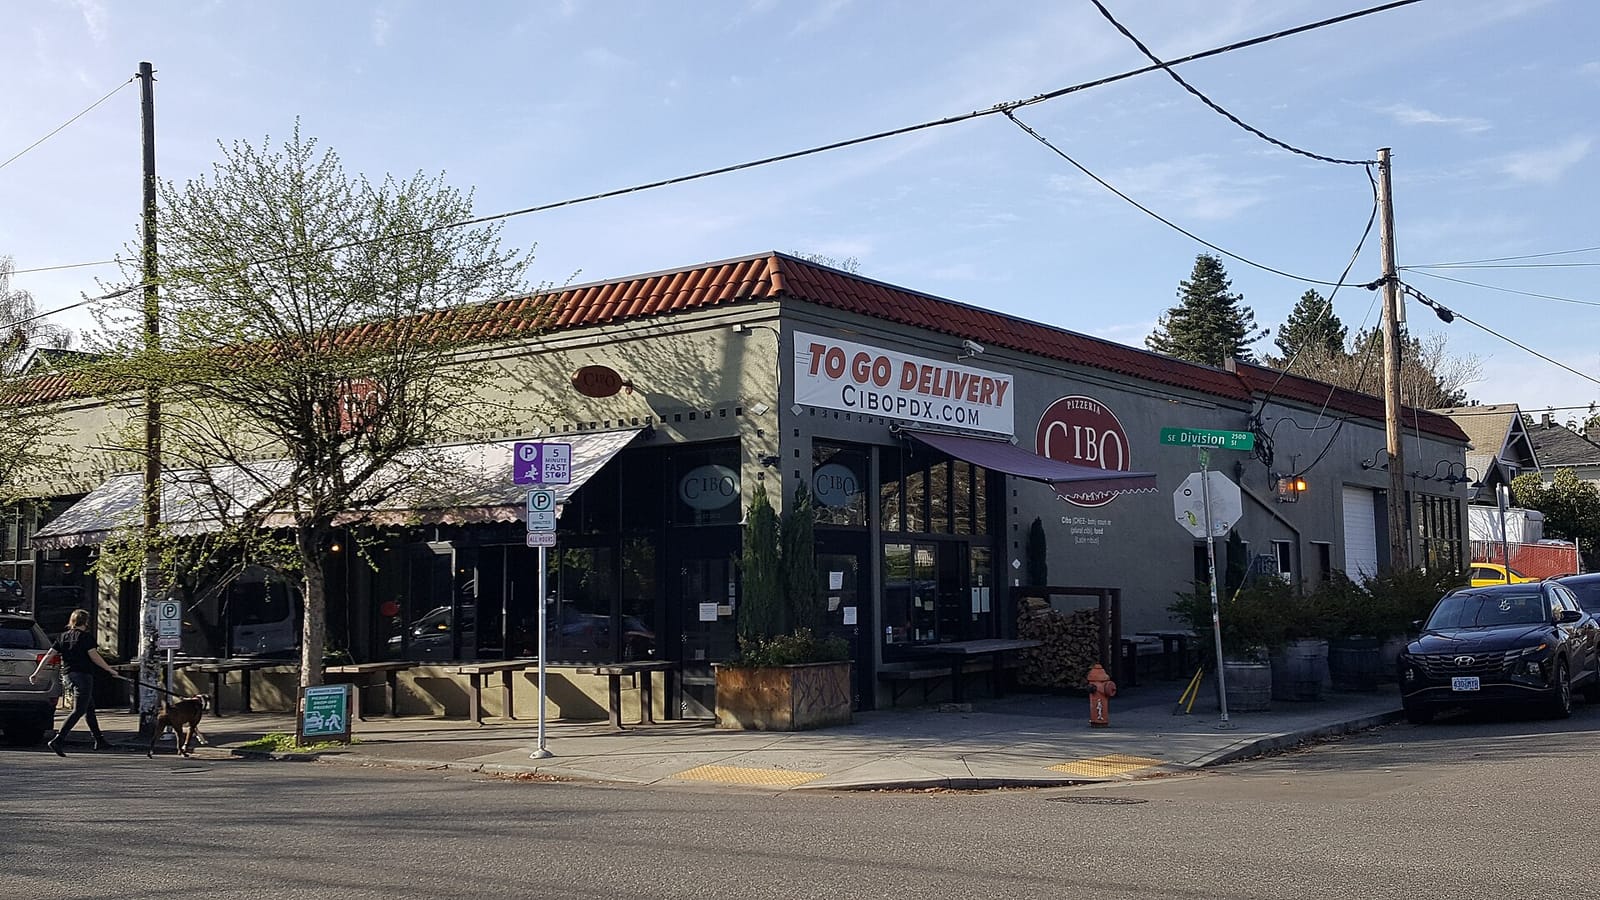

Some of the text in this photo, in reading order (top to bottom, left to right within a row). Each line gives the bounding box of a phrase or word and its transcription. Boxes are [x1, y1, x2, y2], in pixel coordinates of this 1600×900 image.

[809, 342, 1010, 407] TO GO DELIVERY
[841, 384, 980, 426] CIBOPDX.COM
[1066, 400, 1101, 415] PIZZERIA
[1167, 432, 1225, 445] SE Division
[1044, 420, 1123, 472] CIBO
[524, 447, 533, 459] P
[553, 449, 559, 457] 5
[545, 463, 567, 471] FAST
[545, 471, 567, 479] STOP
[684, 475, 735, 500] CIBO
[816, 474, 856, 497] CIBO
[537, 495, 547, 507] P
[166, 606, 174, 616] P
